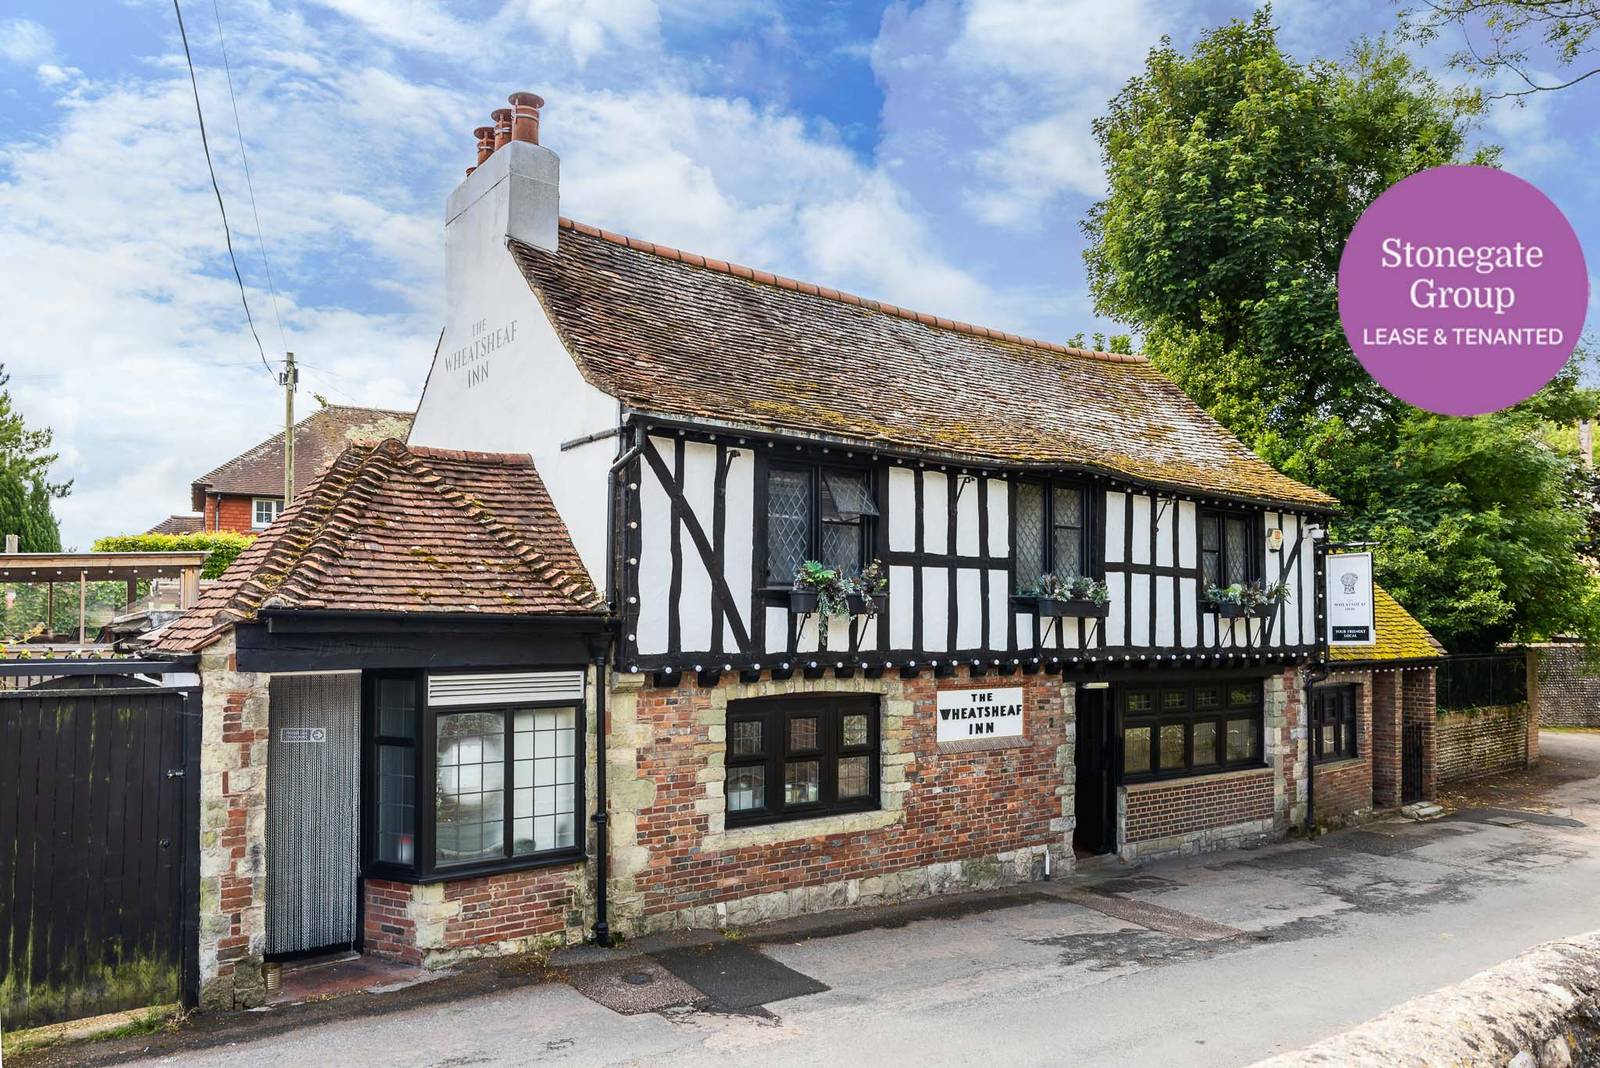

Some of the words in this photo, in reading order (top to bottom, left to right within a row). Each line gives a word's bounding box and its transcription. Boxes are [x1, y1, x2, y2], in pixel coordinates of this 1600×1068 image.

[472, 318, 487, 338] THE
[445, 319, 518, 373] WHEATSHEAF
[467, 360, 489, 389] INN
[971, 692, 993, 702] THE
[940, 704, 1022, 721] WHEATSHEAF
[969, 722, 994, 735] INN
